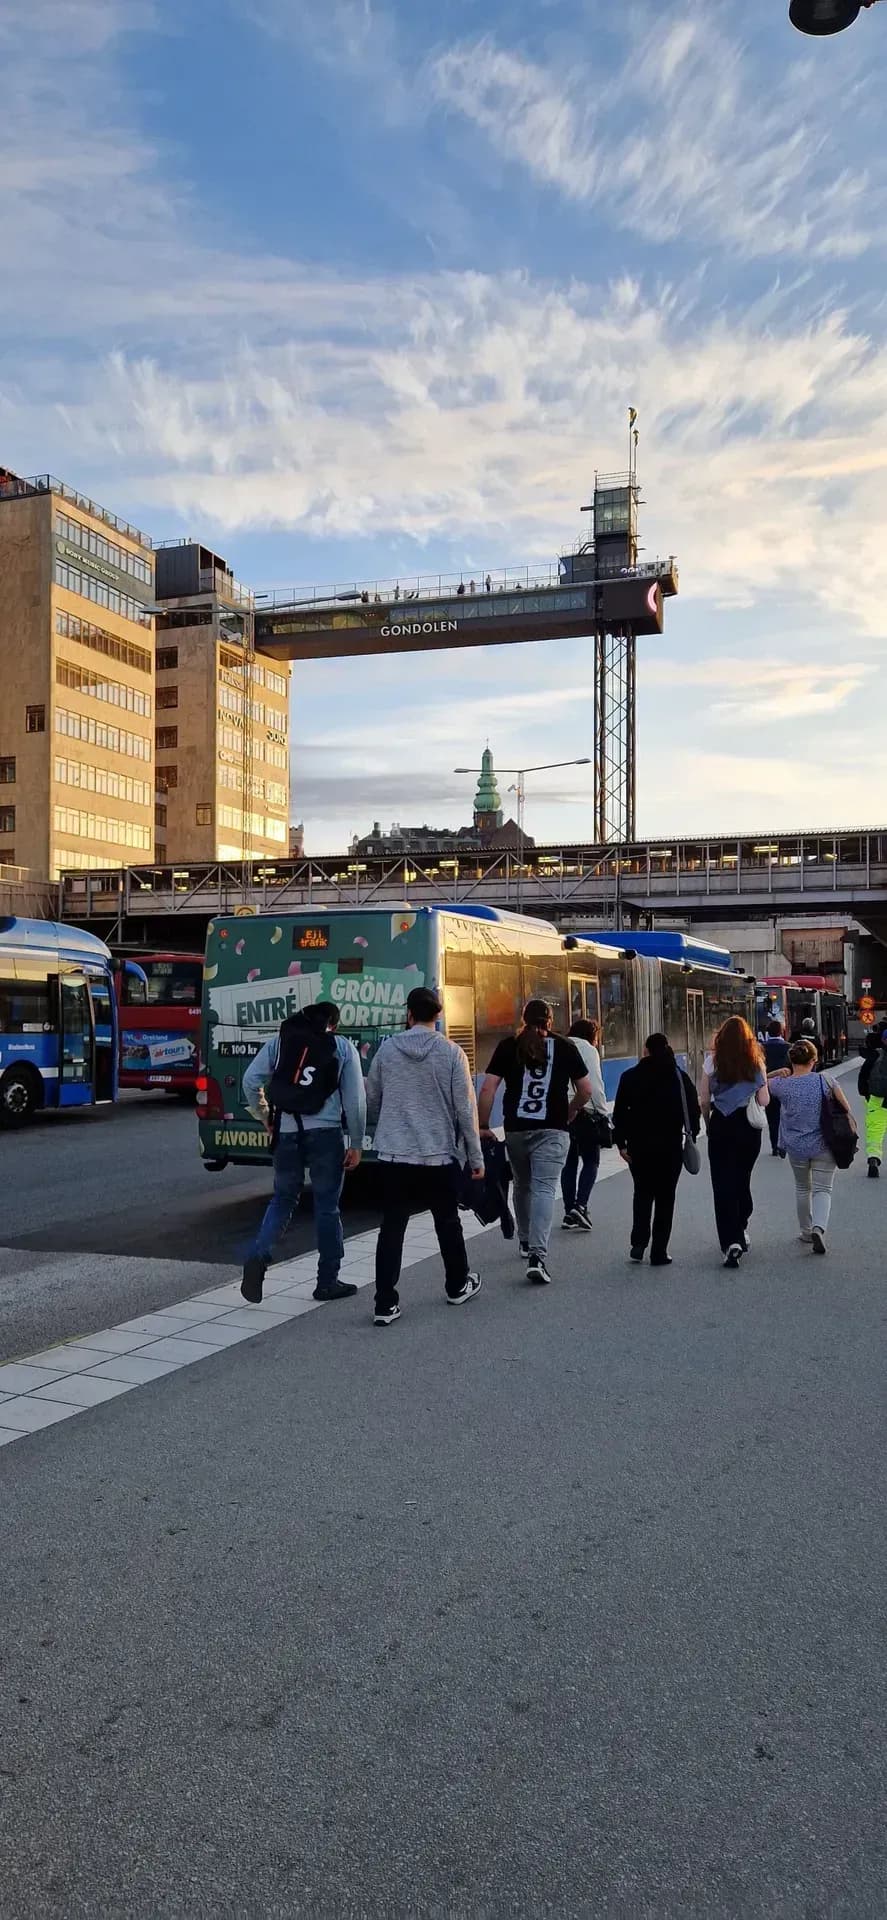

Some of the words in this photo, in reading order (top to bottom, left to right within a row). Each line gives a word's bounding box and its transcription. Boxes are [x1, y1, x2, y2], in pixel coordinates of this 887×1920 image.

[380, 620, 458, 637] GONDOLEN
[300, 938, 328, 948] trafik
[331, 975, 405, 1006] GRÖNA
[236, 988, 297, 1025] ENTRÉ
[154, 1046, 185, 1058] airtours
[220, 1044, 230, 1055] fr.
[231, 1045, 246, 1055] 100
[247, 1044, 258, 1055] kr
